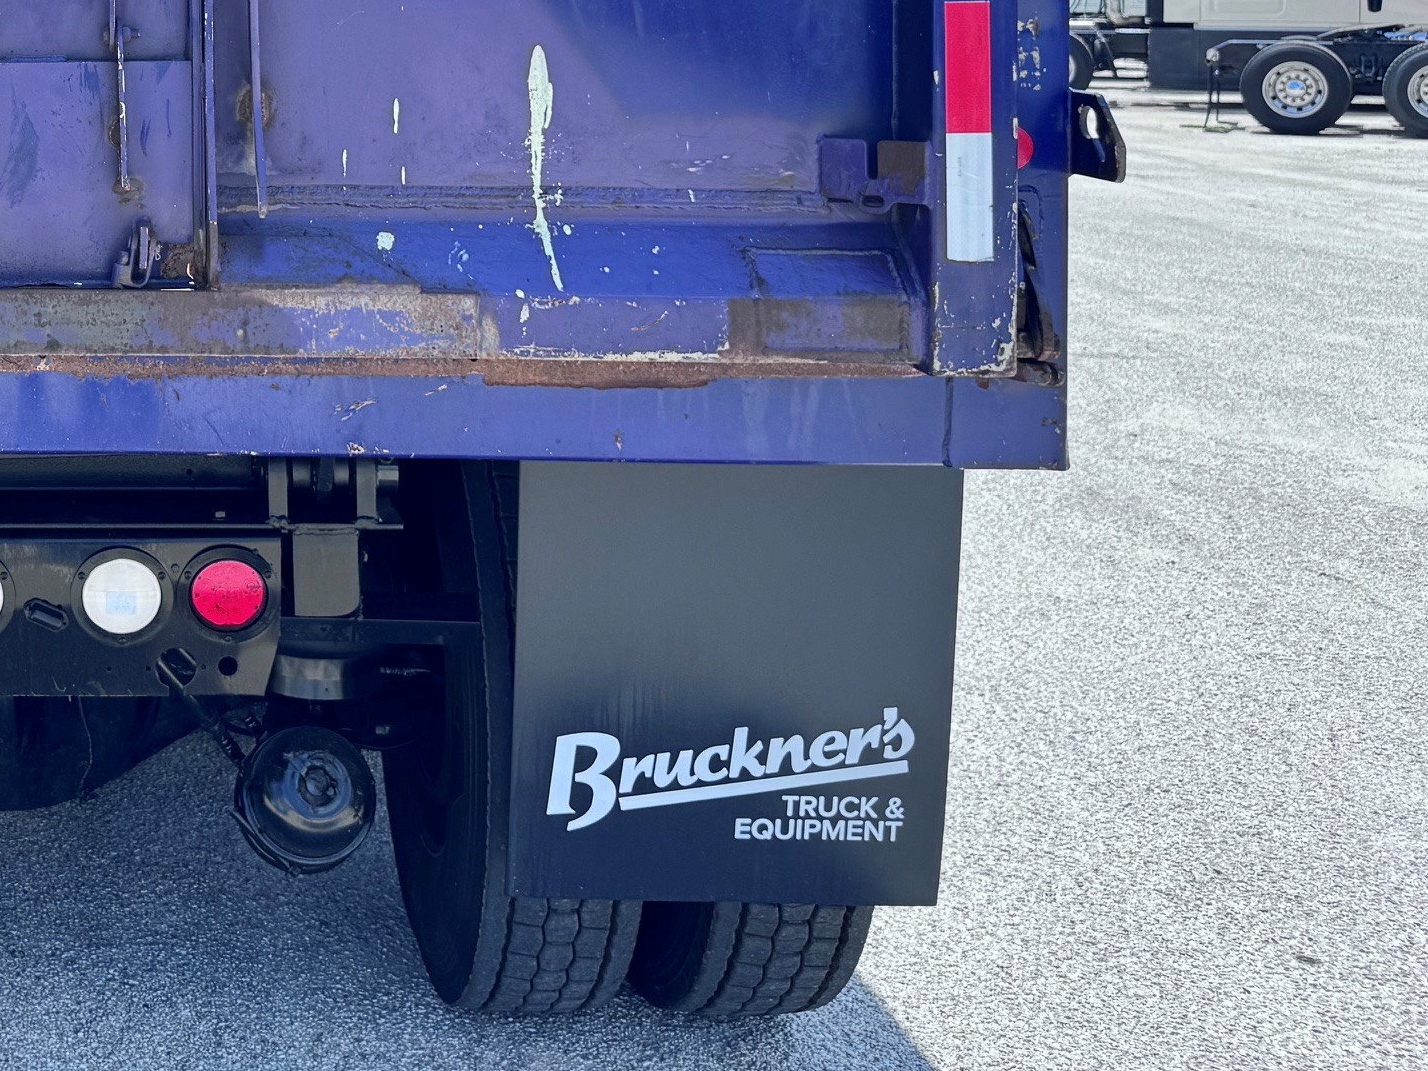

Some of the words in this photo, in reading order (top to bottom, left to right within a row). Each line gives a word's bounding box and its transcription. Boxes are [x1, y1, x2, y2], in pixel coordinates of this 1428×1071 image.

[546, 706, 916, 832] Bruckner's
[781, 795, 878, 819] TRUCK
[884, 797, 905, 819] &
[734, 817, 904, 842] EQUIPMENT
